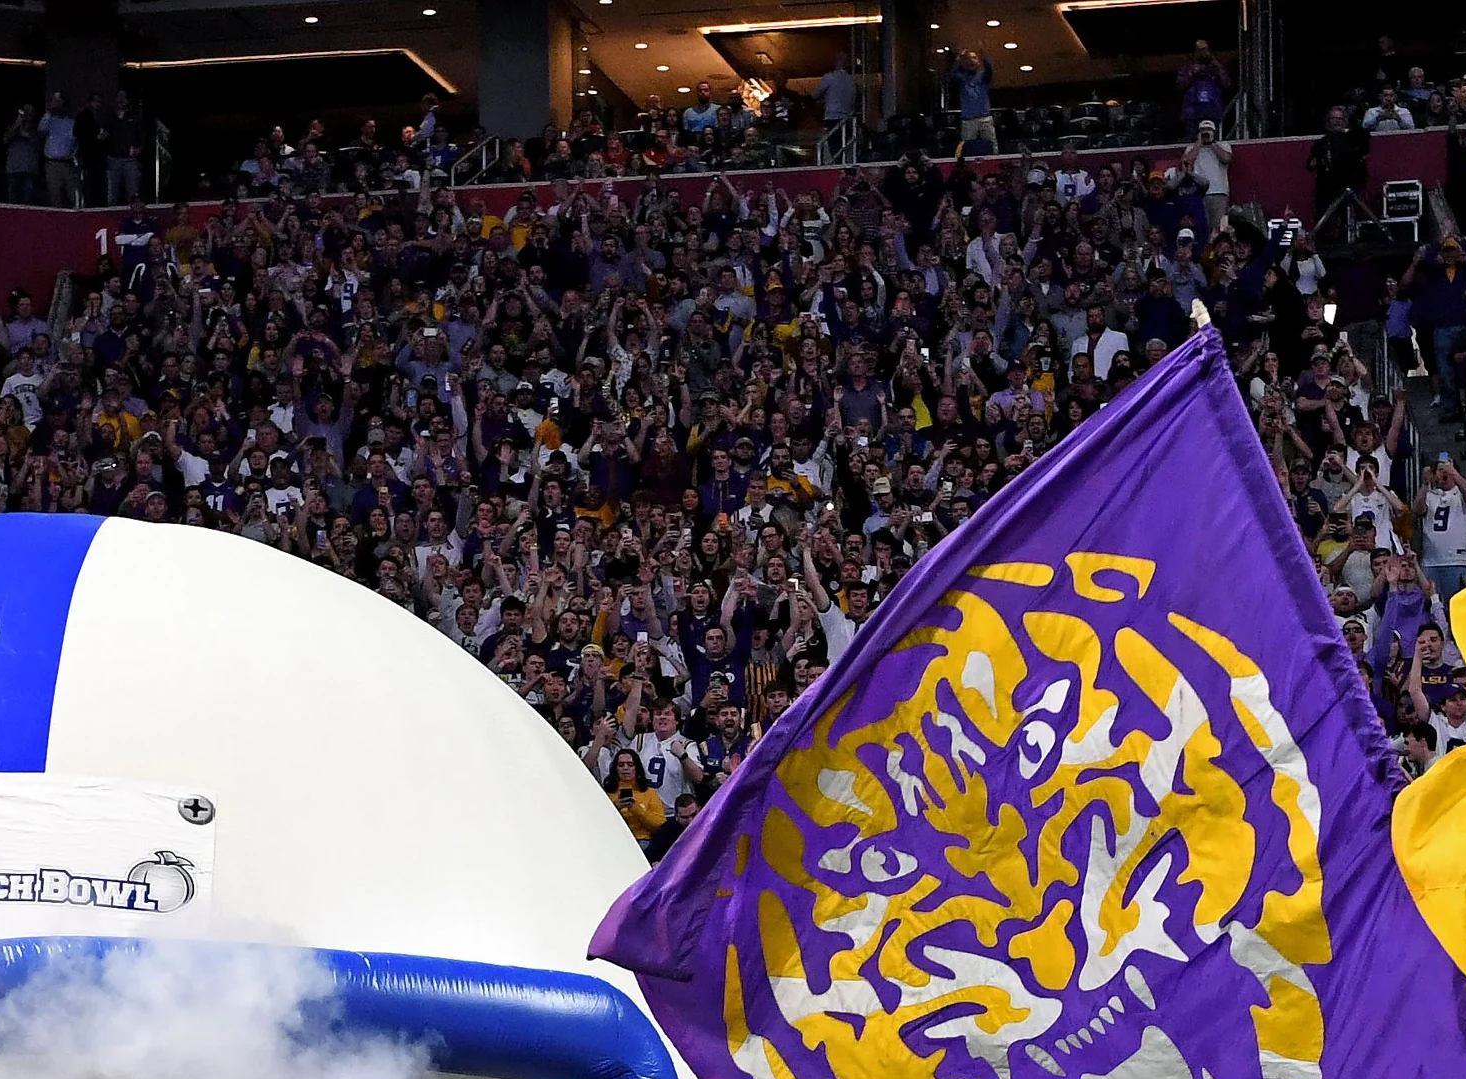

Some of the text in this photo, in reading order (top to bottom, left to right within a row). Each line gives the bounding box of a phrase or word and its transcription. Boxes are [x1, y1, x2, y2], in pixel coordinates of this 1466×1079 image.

[1433, 506, 1450, 531] 9
[647, 757, 665, 789] 9
[40, 869, 158, 911] BOWL
